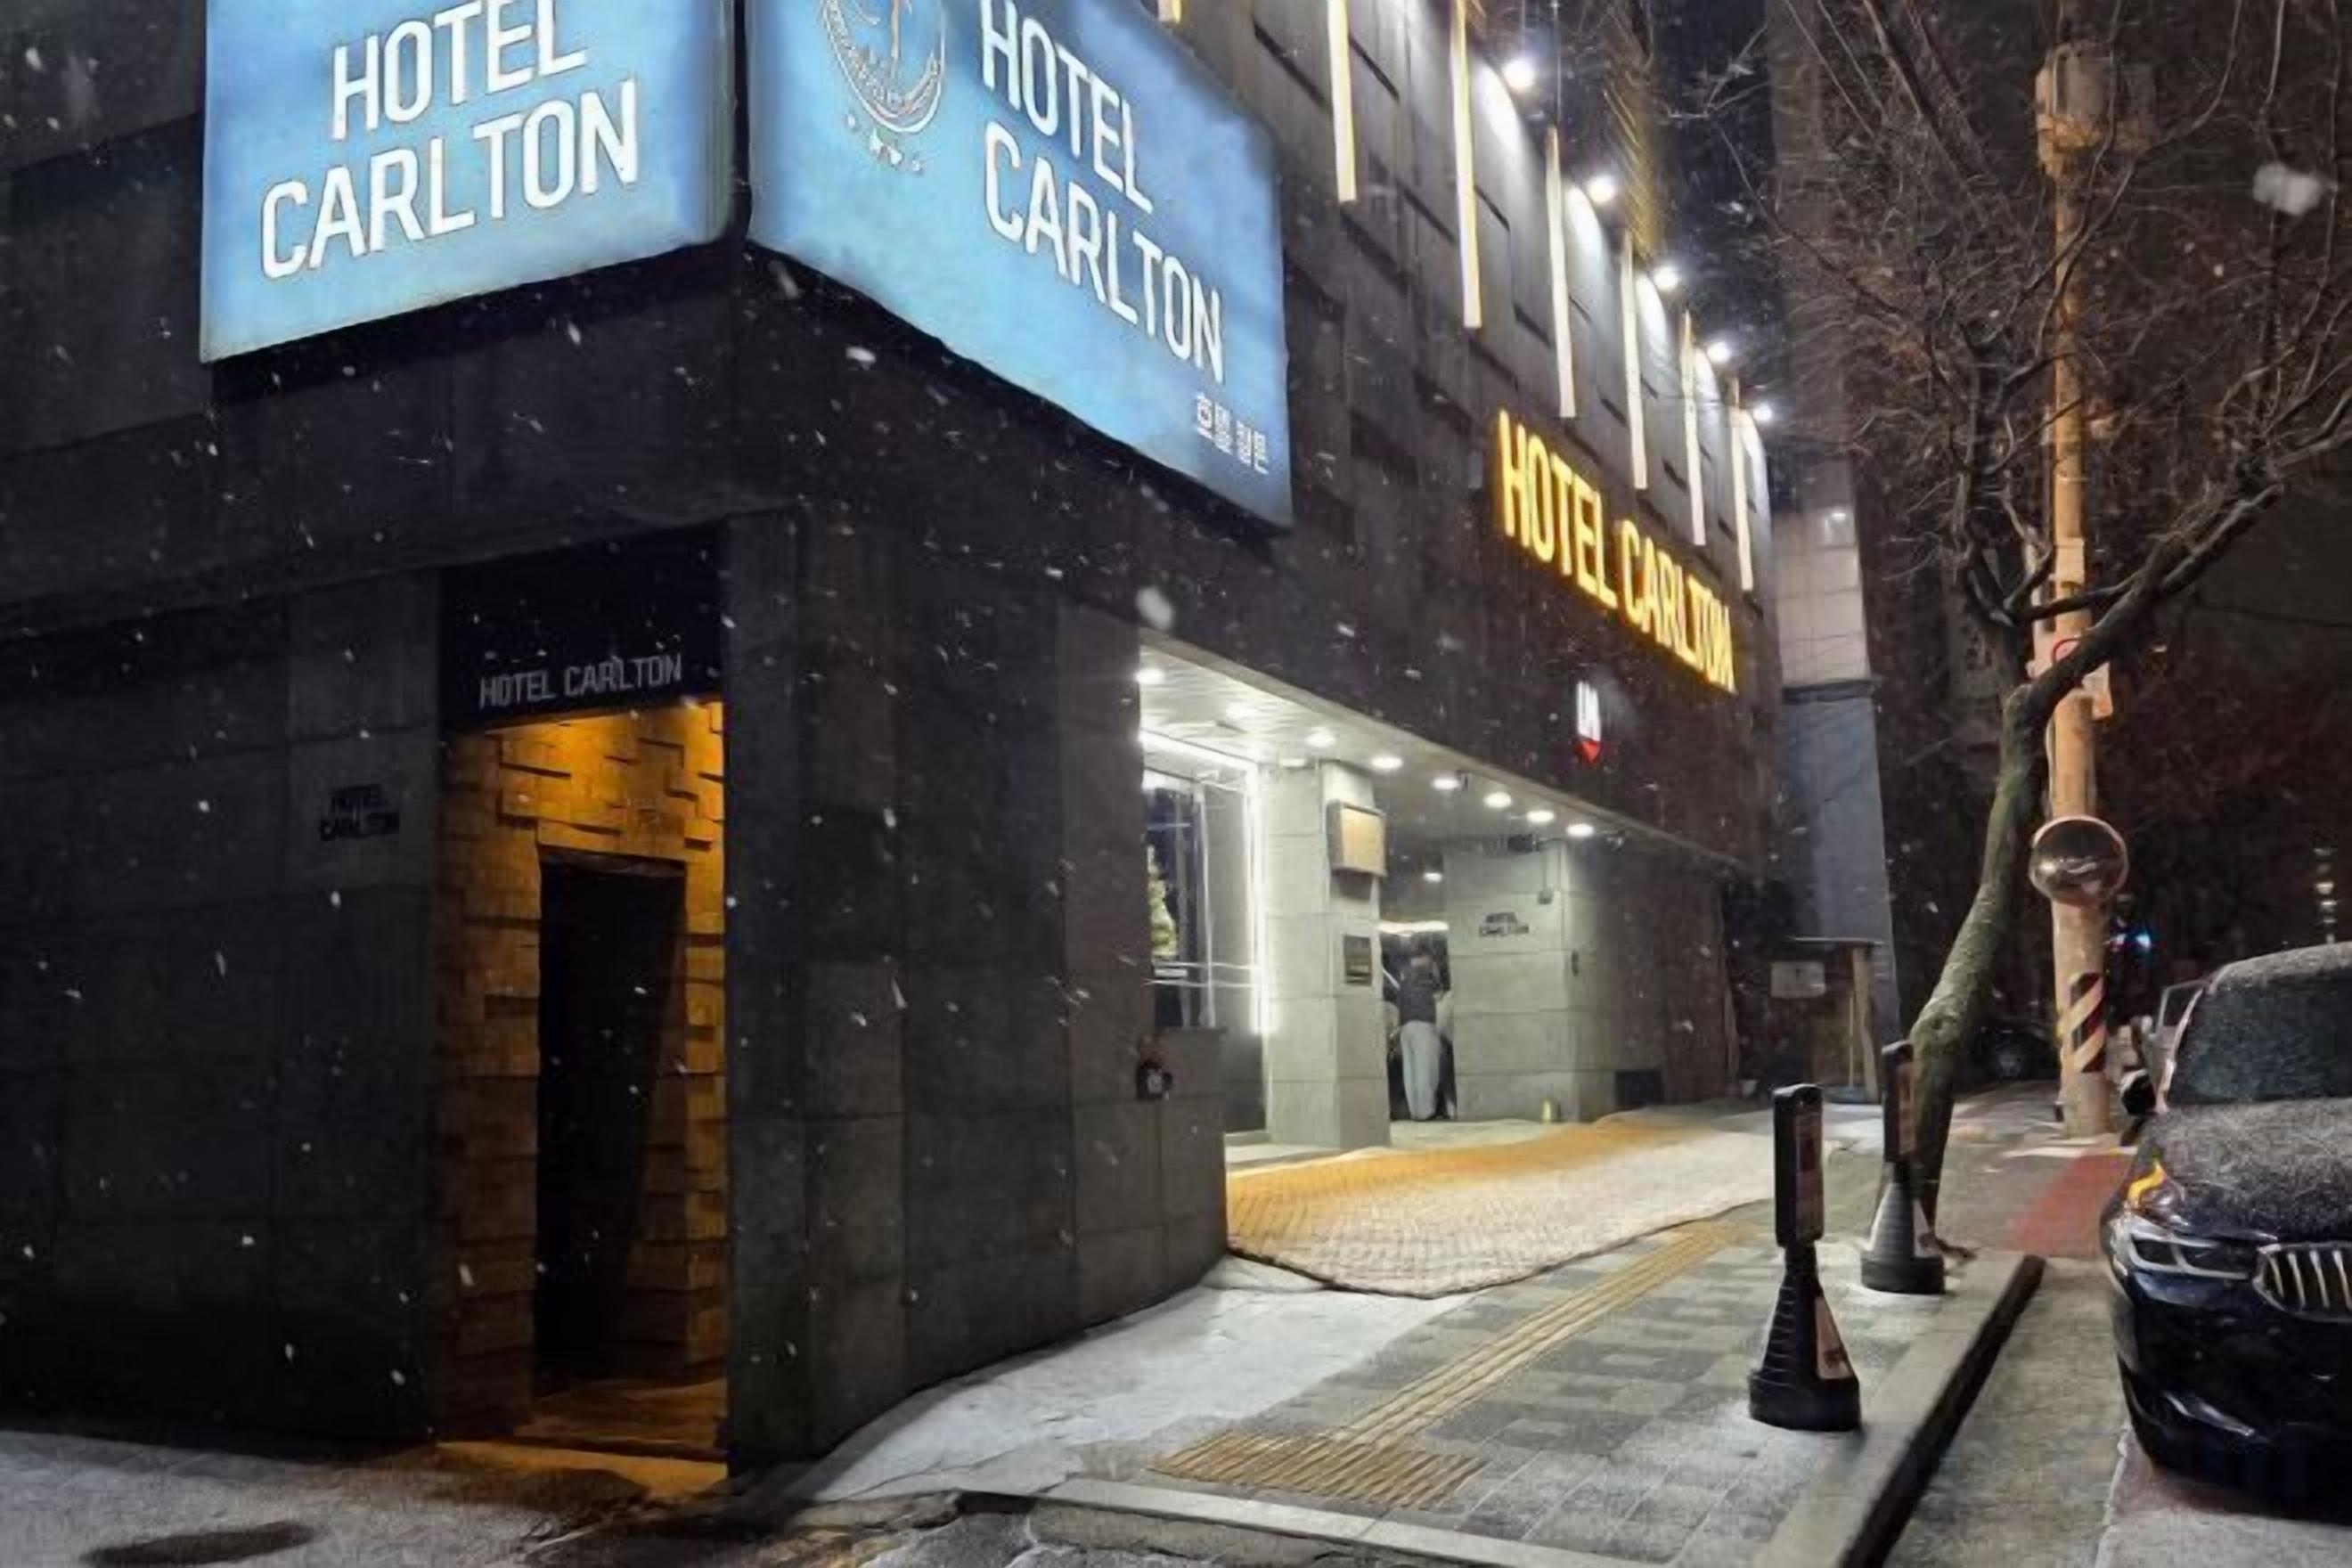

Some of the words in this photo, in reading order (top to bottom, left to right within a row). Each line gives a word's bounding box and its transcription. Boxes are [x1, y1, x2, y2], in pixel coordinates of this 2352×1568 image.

[331, 0, 586, 140] HOTEL
[980, 0, 1154, 214] HOTEL
[261, 79, 639, 278] CARLTON
[984, 121, 1224, 383] CARLTON
[1499, 409, 1617, 608] HOTEL
[1620, 519, 1735, 693] CARLTON
[479, 670, 558, 710] HOTEL
[564, 653, 682, 697] CARLTON
